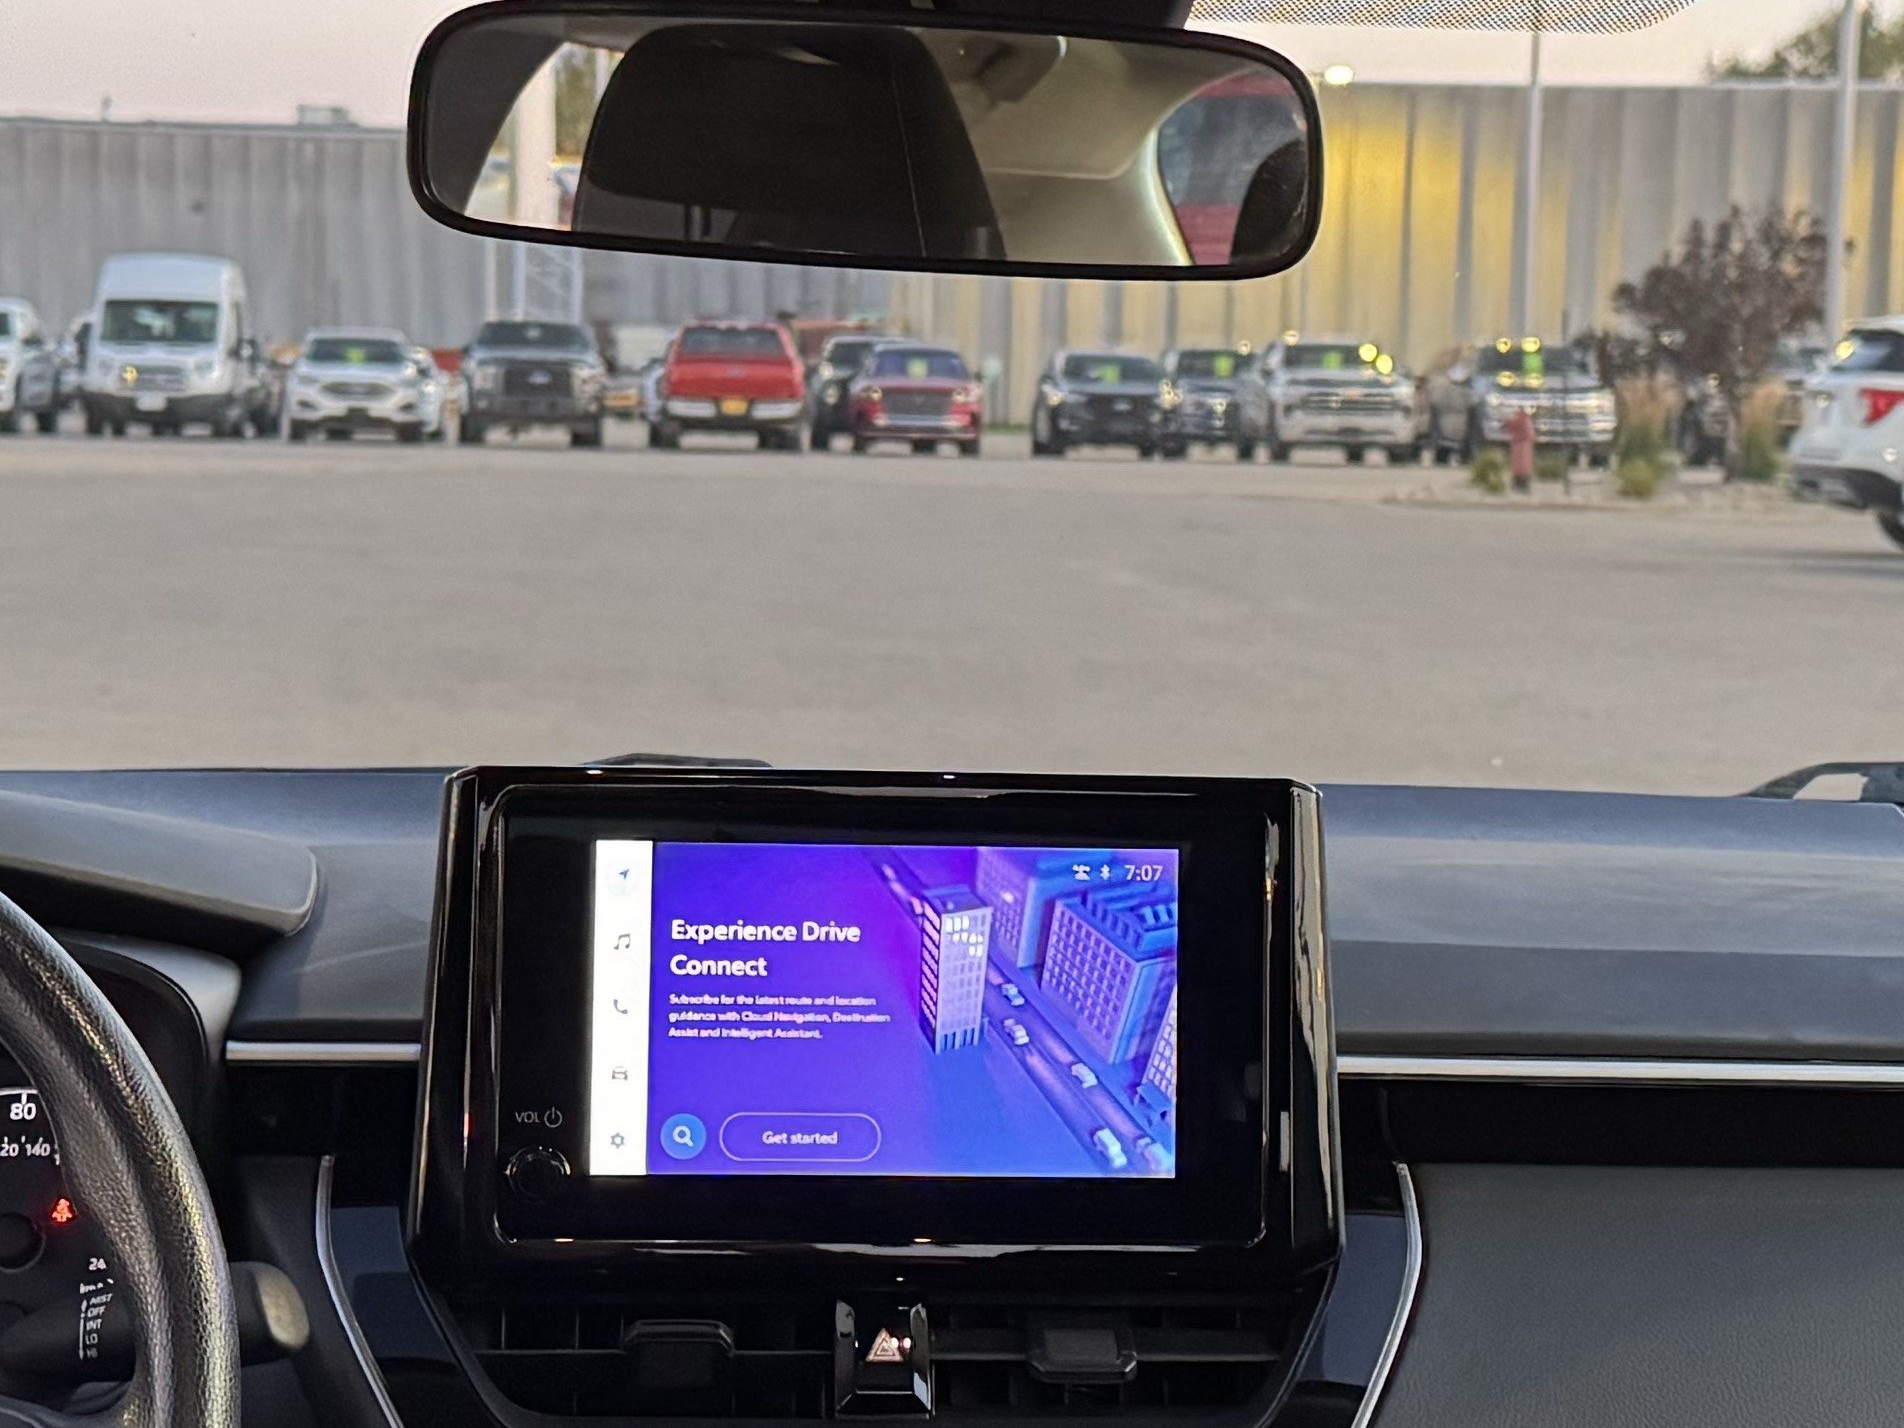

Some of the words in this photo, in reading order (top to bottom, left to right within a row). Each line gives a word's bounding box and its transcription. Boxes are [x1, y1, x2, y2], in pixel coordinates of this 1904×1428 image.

[1124, 862, 1163, 882] 7:07
[670, 919, 797, 946] Experience
[802, 920, 861, 943] Drive
[670, 955, 768, 977] Connect
[668, 993, 719, 1005] Subscribe
[721, 994, 735, 1005] for
[736, 994, 754, 1005] the
[755, 994, 785, 1005] latest
[786, 996, 813, 1005] route
[814, 995, 835, 1005] and
[835, 995, 877, 1006] location
[668, 1011, 716, 1023] guidance
[718, 1010, 741, 1021] with
[742, 1010, 773, 1021] Cloud
[832, 1012, 891, 1022] Destination
[668, 1027, 698, 1038] Assist
[699, 1028, 721, 1038] and
[722, 1028, 773, 1040] Intelligent
[9, 1102, 37, 1120] 80
[515, 1111, 540, 1123] VOL
[762, 1129, 789, 1146] Get
[791, 1130, 838, 1146] started
[25, 1142, 51, 1157] 140
[87, 1305, 106, 1318] OFF
[86, 1318, 102, 1331] INT
